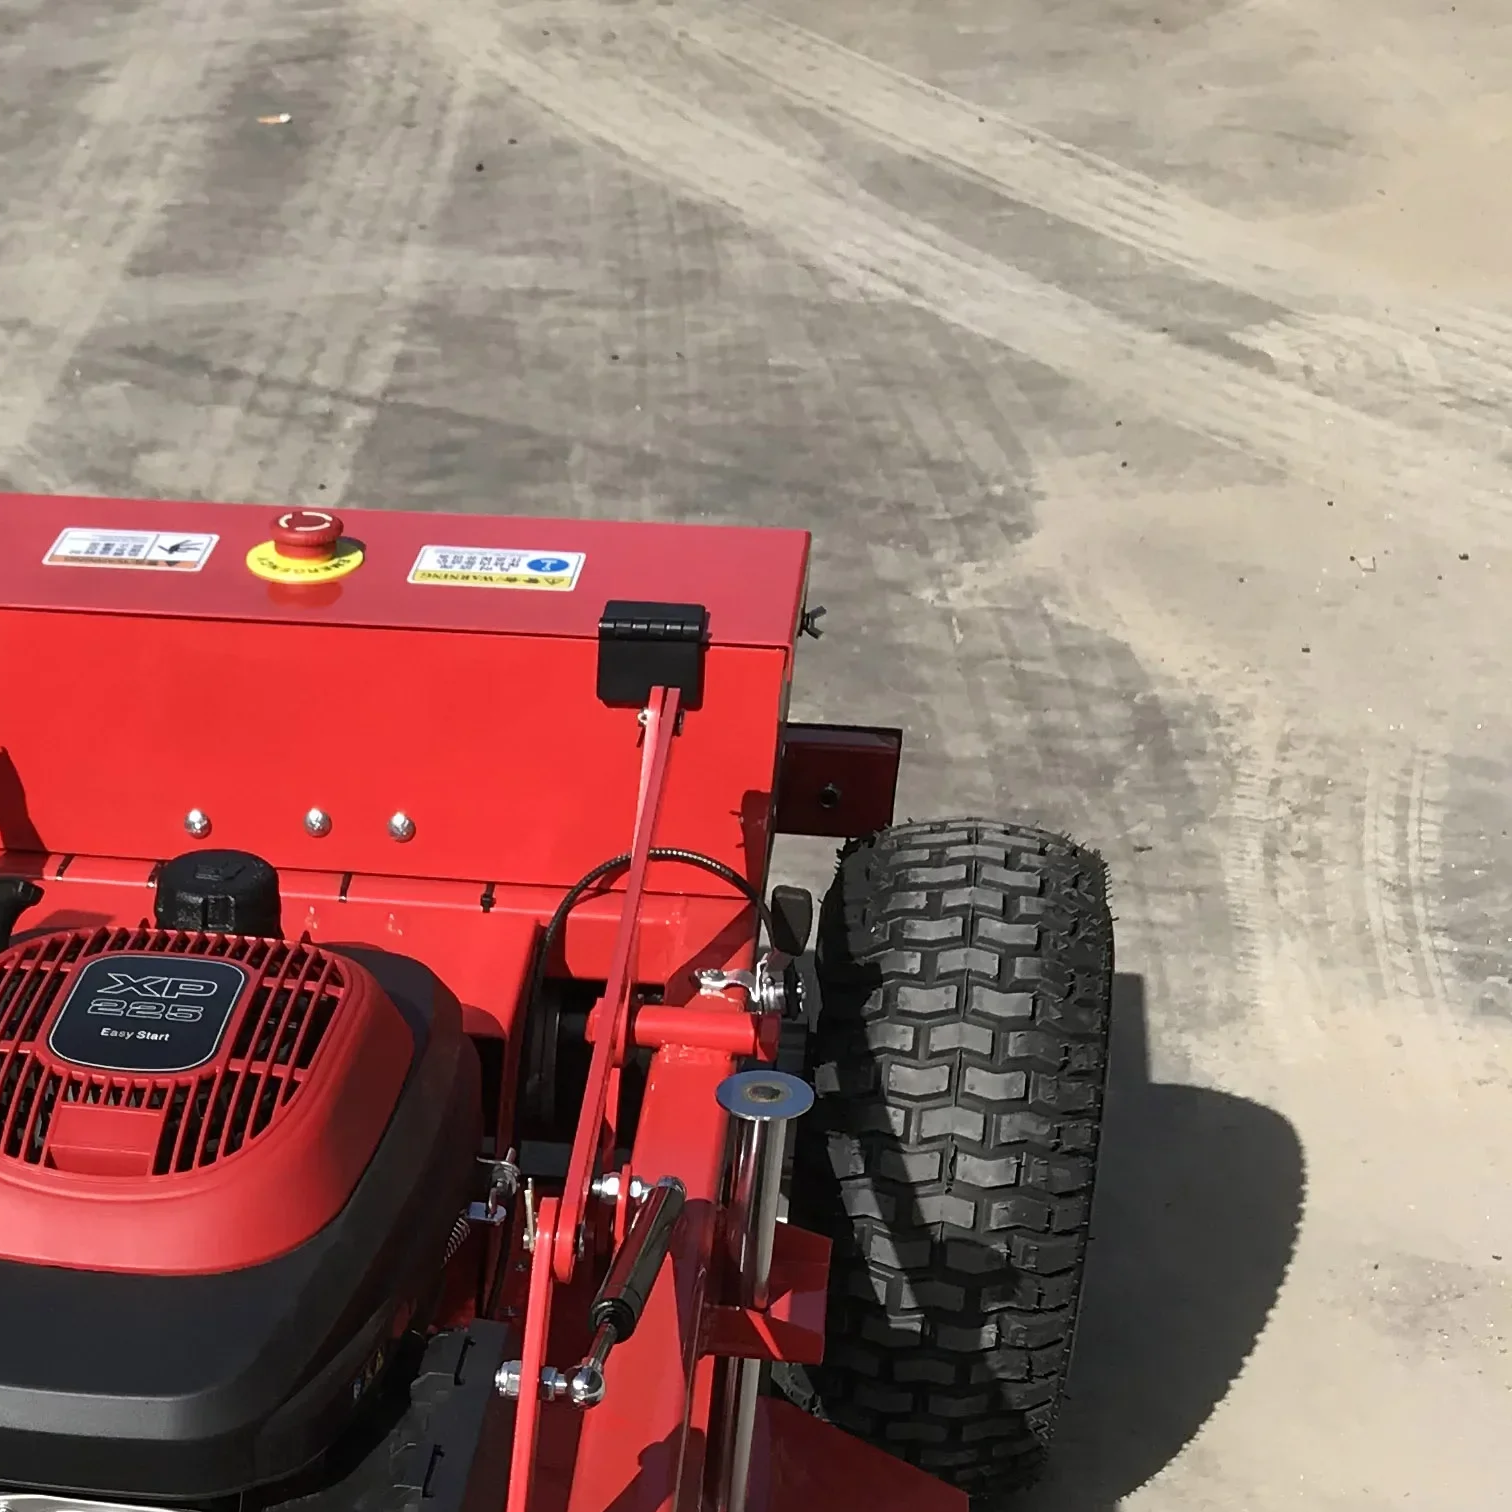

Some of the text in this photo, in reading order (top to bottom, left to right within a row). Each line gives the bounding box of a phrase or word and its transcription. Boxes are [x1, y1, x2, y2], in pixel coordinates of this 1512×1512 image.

[97, 972, 217, 999] XP
[87, 998, 204, 1023] 225
[100, 1027, 170, 1043] Easy Start
